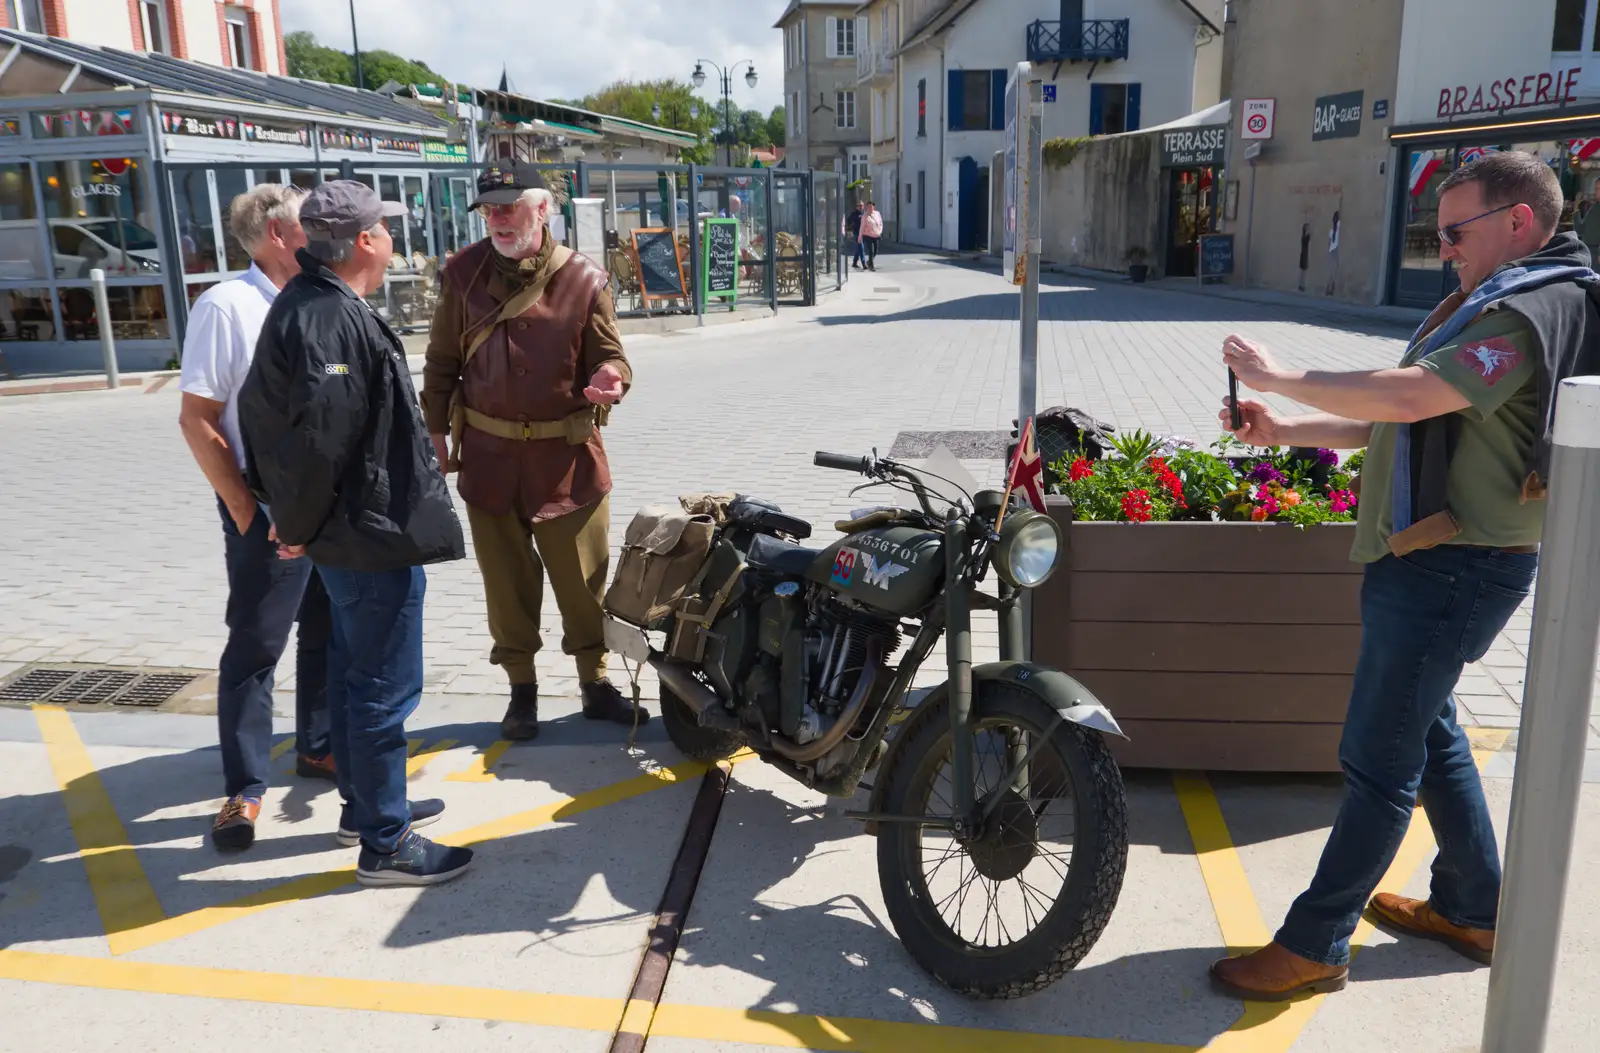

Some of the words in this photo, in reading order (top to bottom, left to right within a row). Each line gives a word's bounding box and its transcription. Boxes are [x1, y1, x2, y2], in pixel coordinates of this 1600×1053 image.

[1437, 67, 1582, 118] BRASSERIE
[185, 117, 217, 136] Bar
[1251, 118, 1264, 129] 30
[1163, 129, 1225, 152] TERRASSE
[1172, 151, 1194, 163] Plein
[1196, 150, 1214, 162] Sud
[71, 183, 122, 198] GLACES
[833, 550, 855, 580] 50
